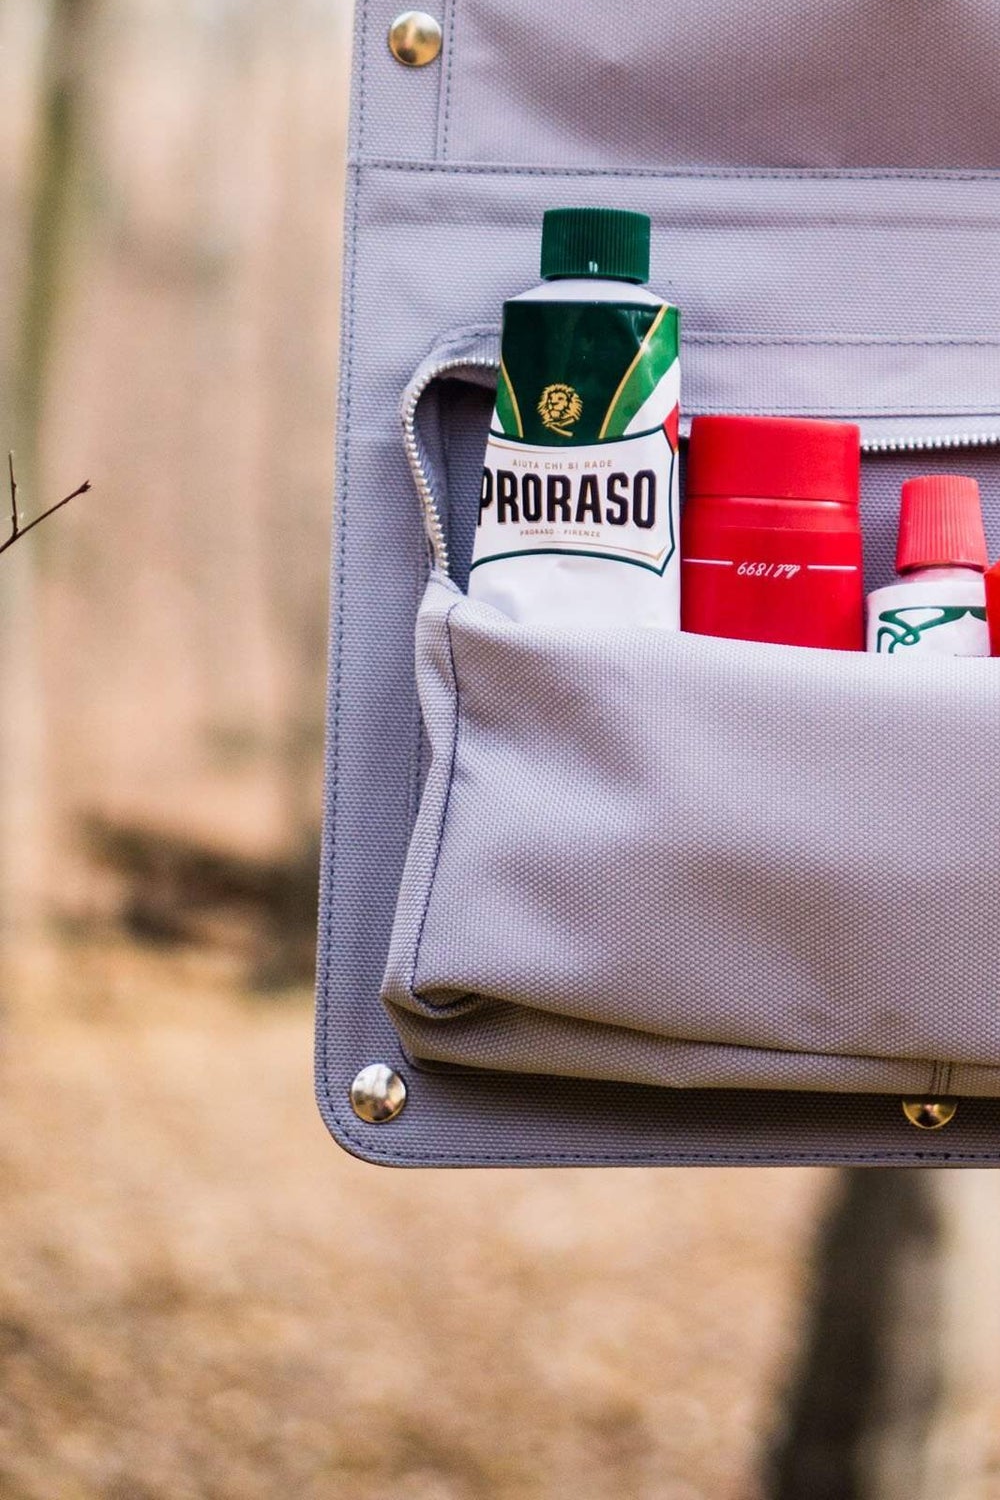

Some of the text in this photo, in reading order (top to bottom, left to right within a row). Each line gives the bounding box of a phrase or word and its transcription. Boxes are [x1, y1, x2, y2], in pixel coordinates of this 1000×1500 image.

[512, 459, 540, 469] AIUTA
[544, 462, 563, 470] CHI
[584, 459, 613, 469] RADE
[477, 466, 657, 530] PRORASO
[737, 562, 801, 579] dal 1899
